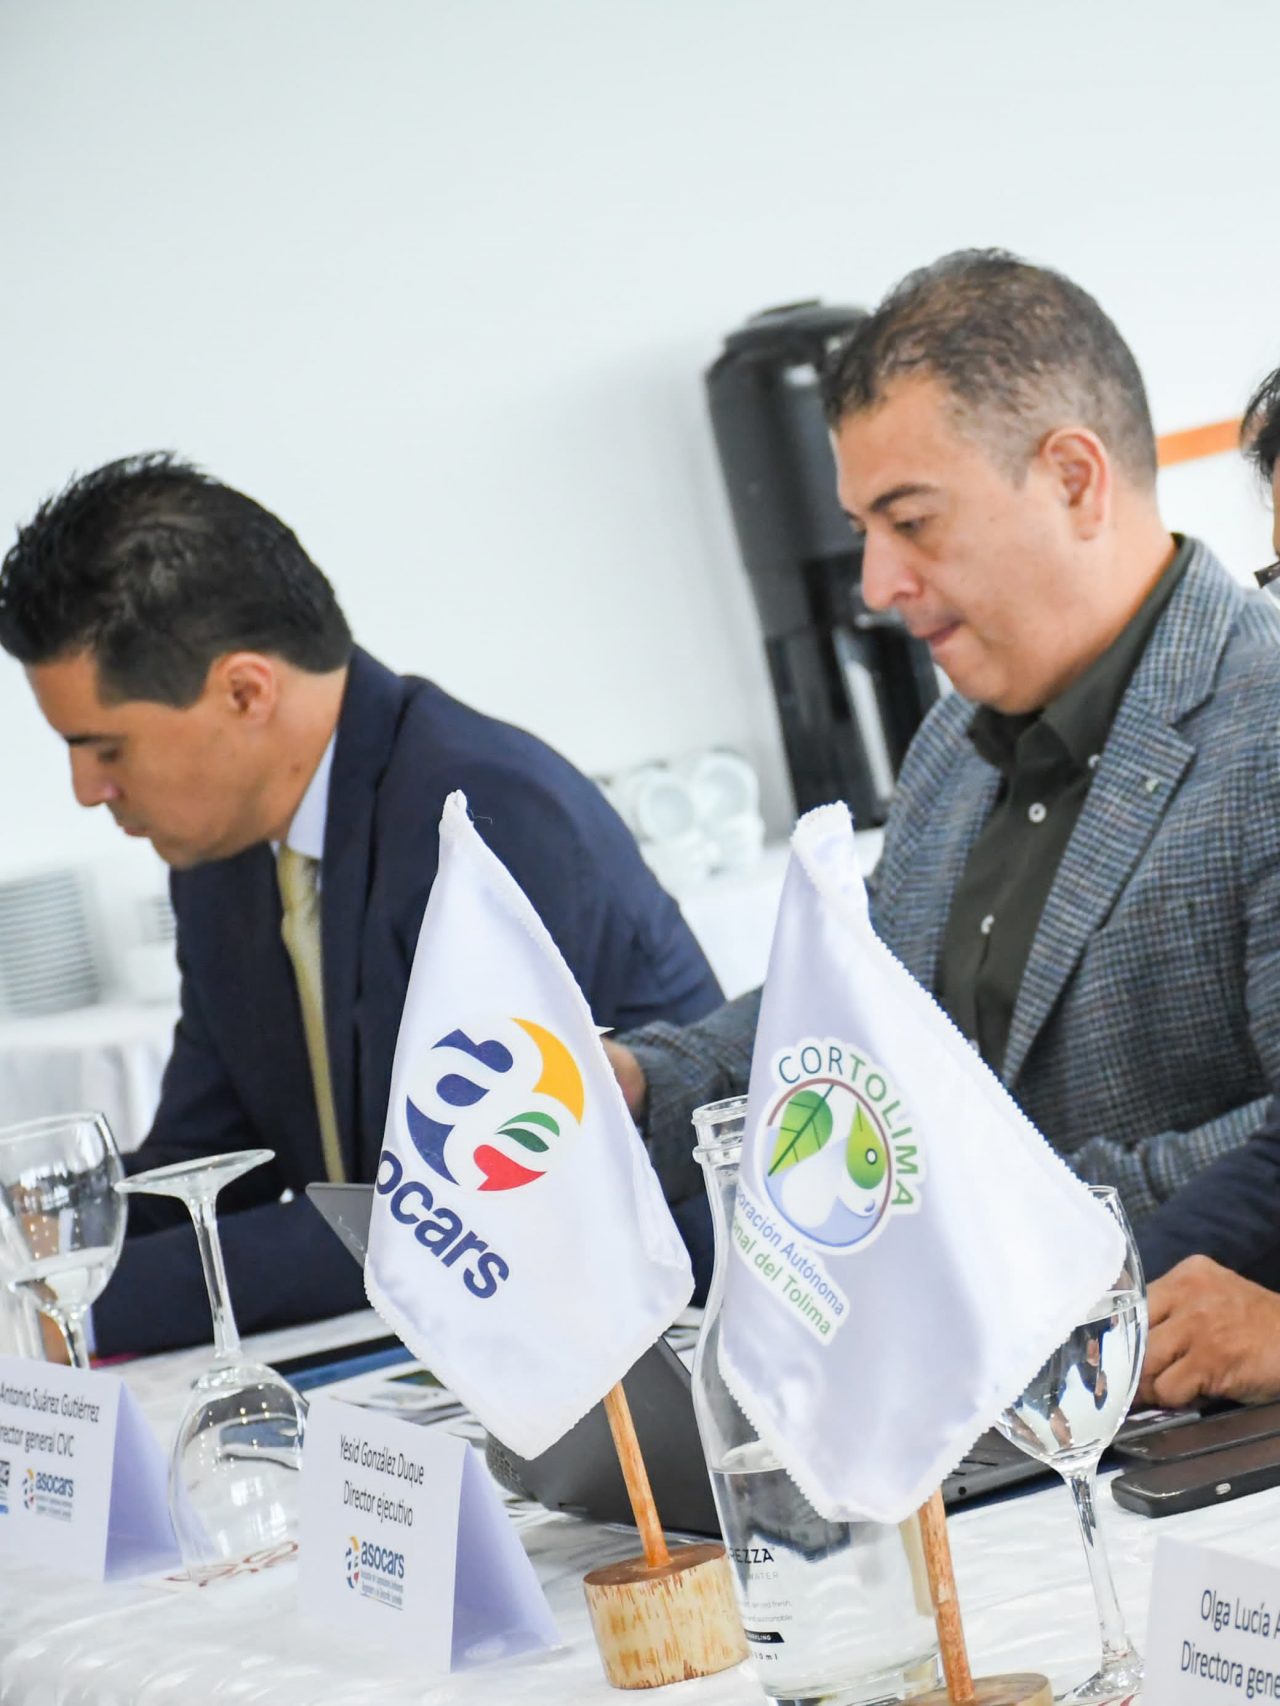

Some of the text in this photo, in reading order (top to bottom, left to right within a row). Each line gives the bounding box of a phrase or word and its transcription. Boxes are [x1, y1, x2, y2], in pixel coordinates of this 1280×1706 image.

[779, 1046, 918, 1205] CORTOLIMA
[736, 1186, 844, 1315] oración Autónoma
[754, 1252, 783, 1281] del
[782, 1274, 831, 1336] Tolima
[32, 1387, 60, 1415] Suárez
[61, 1393, 100, 1423] Gutiérrez
[24, 1427, 55, 1454] general
[57, 1433, 75, 1458] CVC
[340, 1434, 424, 1488] Yesid González Duque
[36, 1471, 74, 1499] asocars
[343, 1479, 413, 1527] Director ejecutivo
[361, 1540, 405, 1579] asocars
[1200, 1589, 1231, 1632] Olga
[1235, 1598, 1270, 1638] Lucía
[1180, 1640, 1243, 1688] Directora
